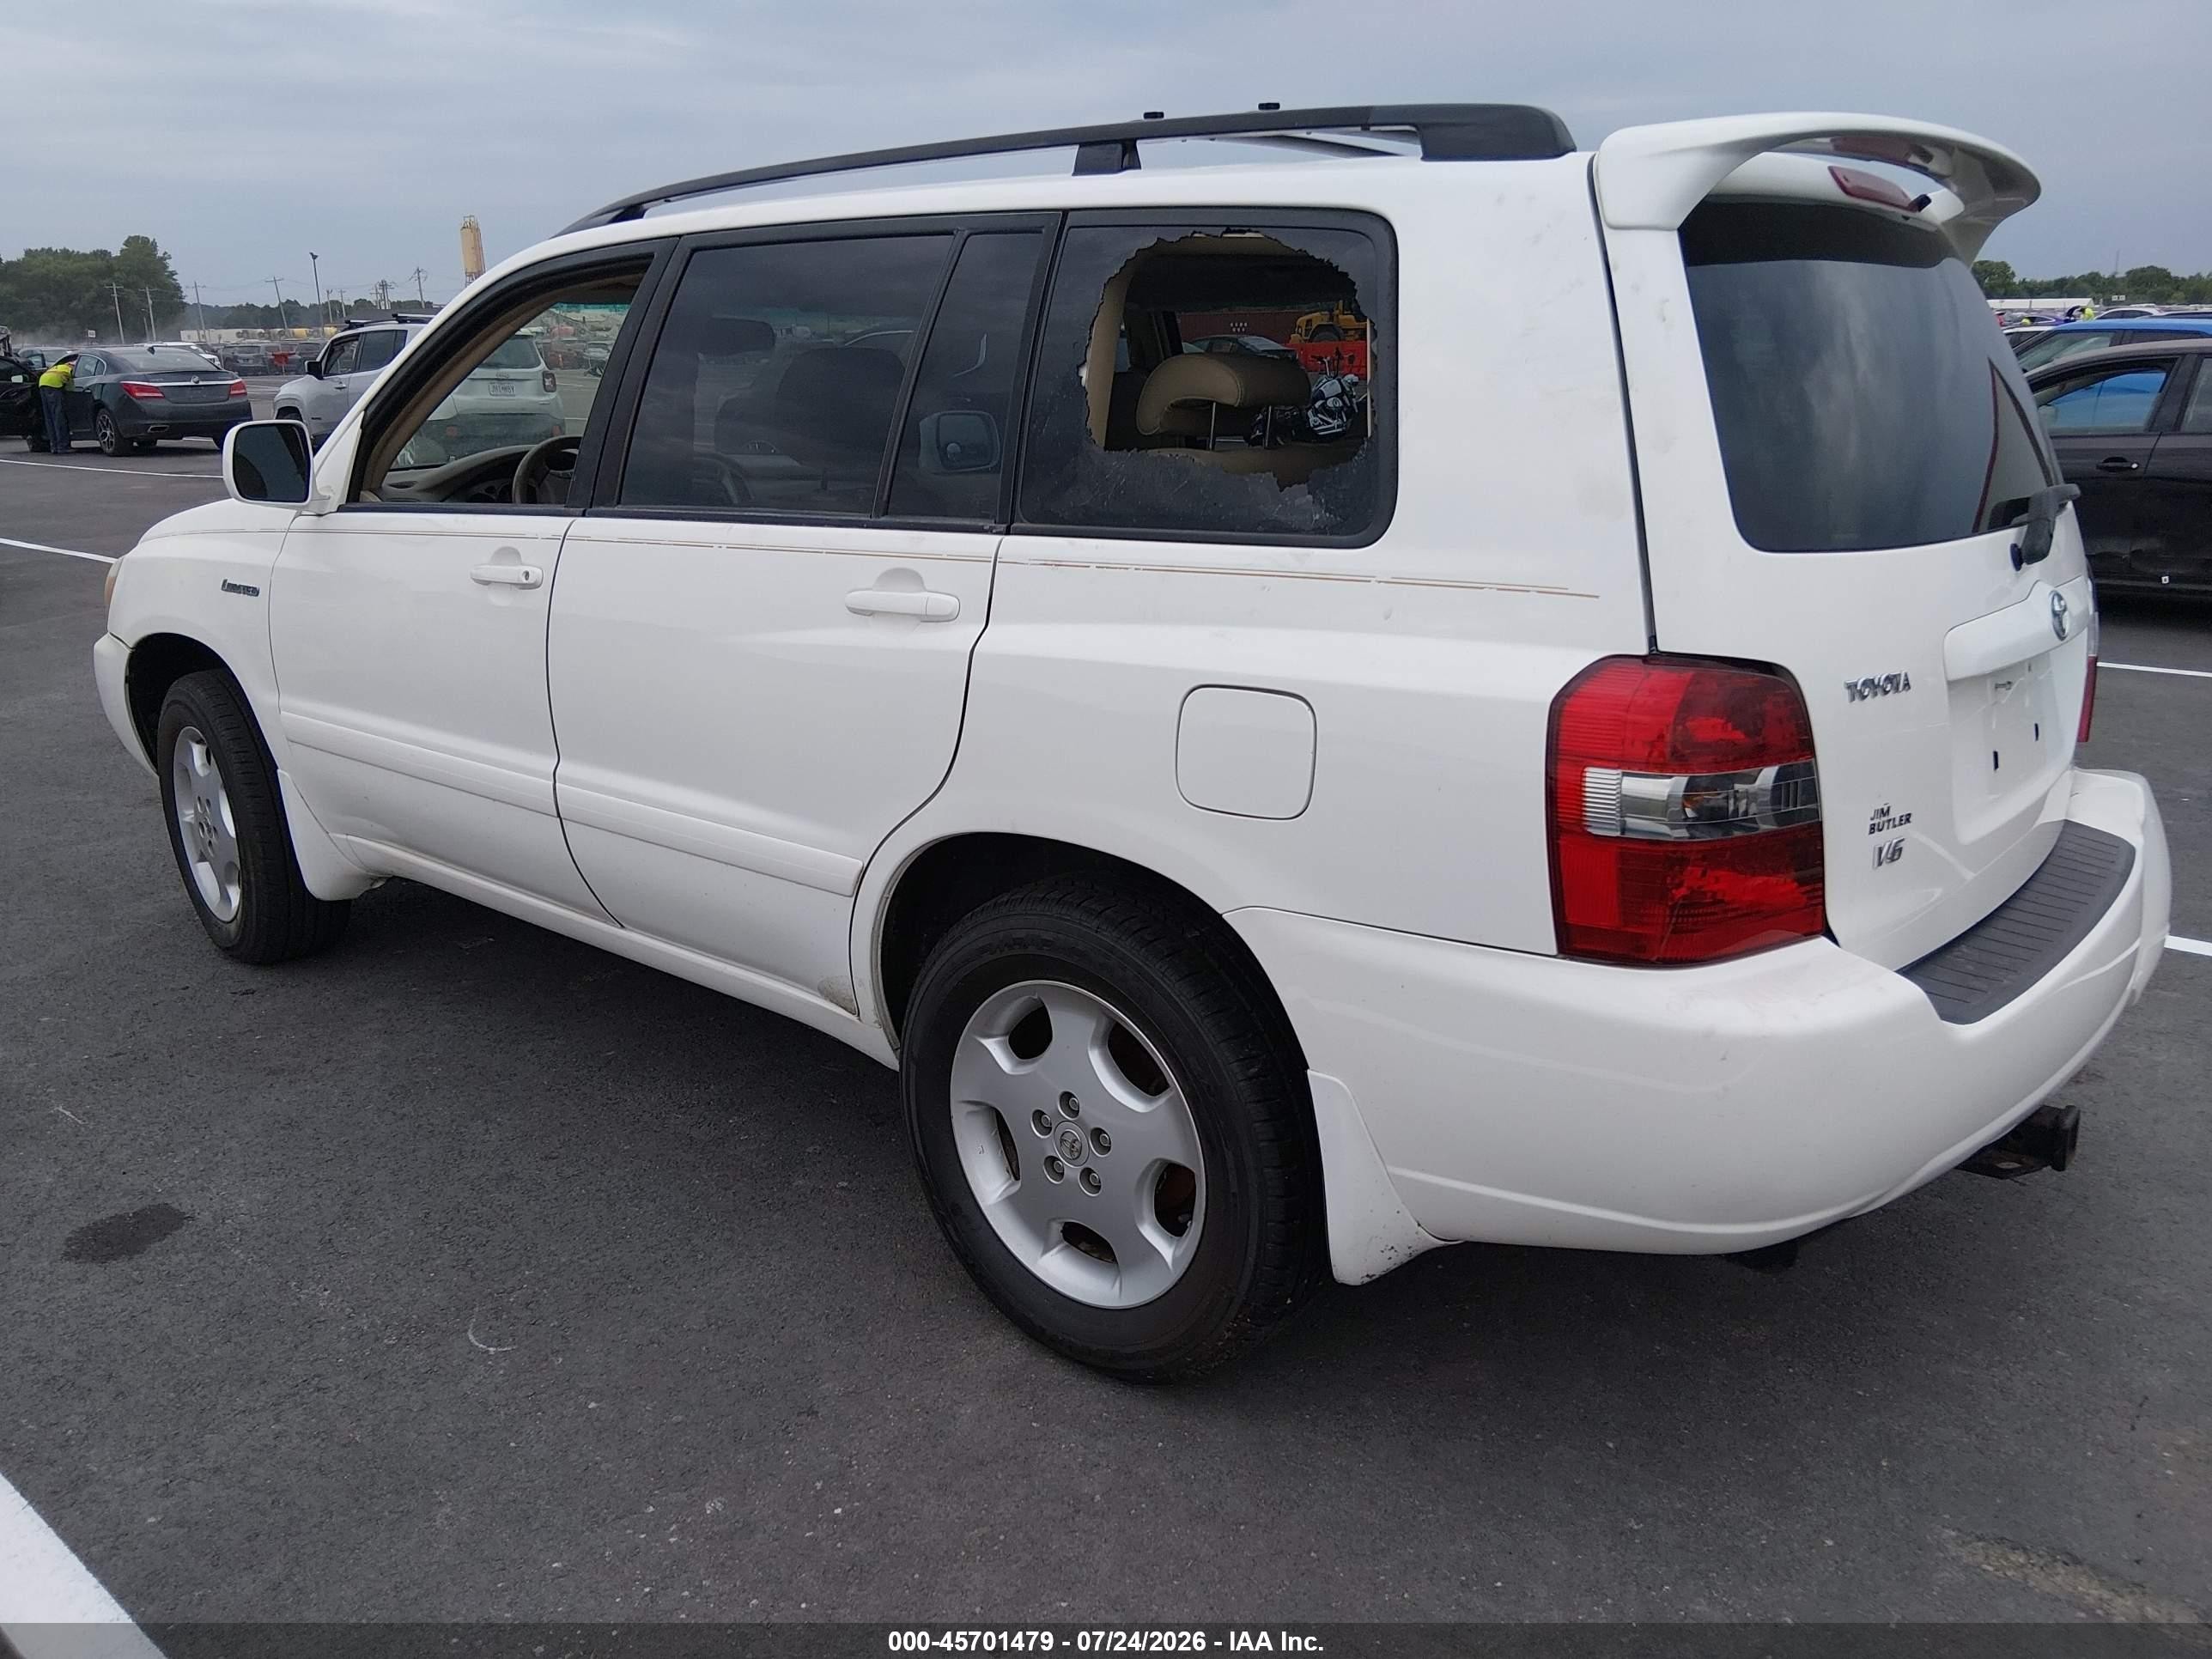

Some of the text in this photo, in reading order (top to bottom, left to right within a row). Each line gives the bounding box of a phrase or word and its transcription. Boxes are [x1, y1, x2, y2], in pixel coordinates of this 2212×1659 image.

[1844, 672, 1911, 702] TOYOTA
[1869, 812, 1911, 835] BUTLER
[1870, 805, 1891, 821] JIM
[1873, 838, 1905, 869] V6
